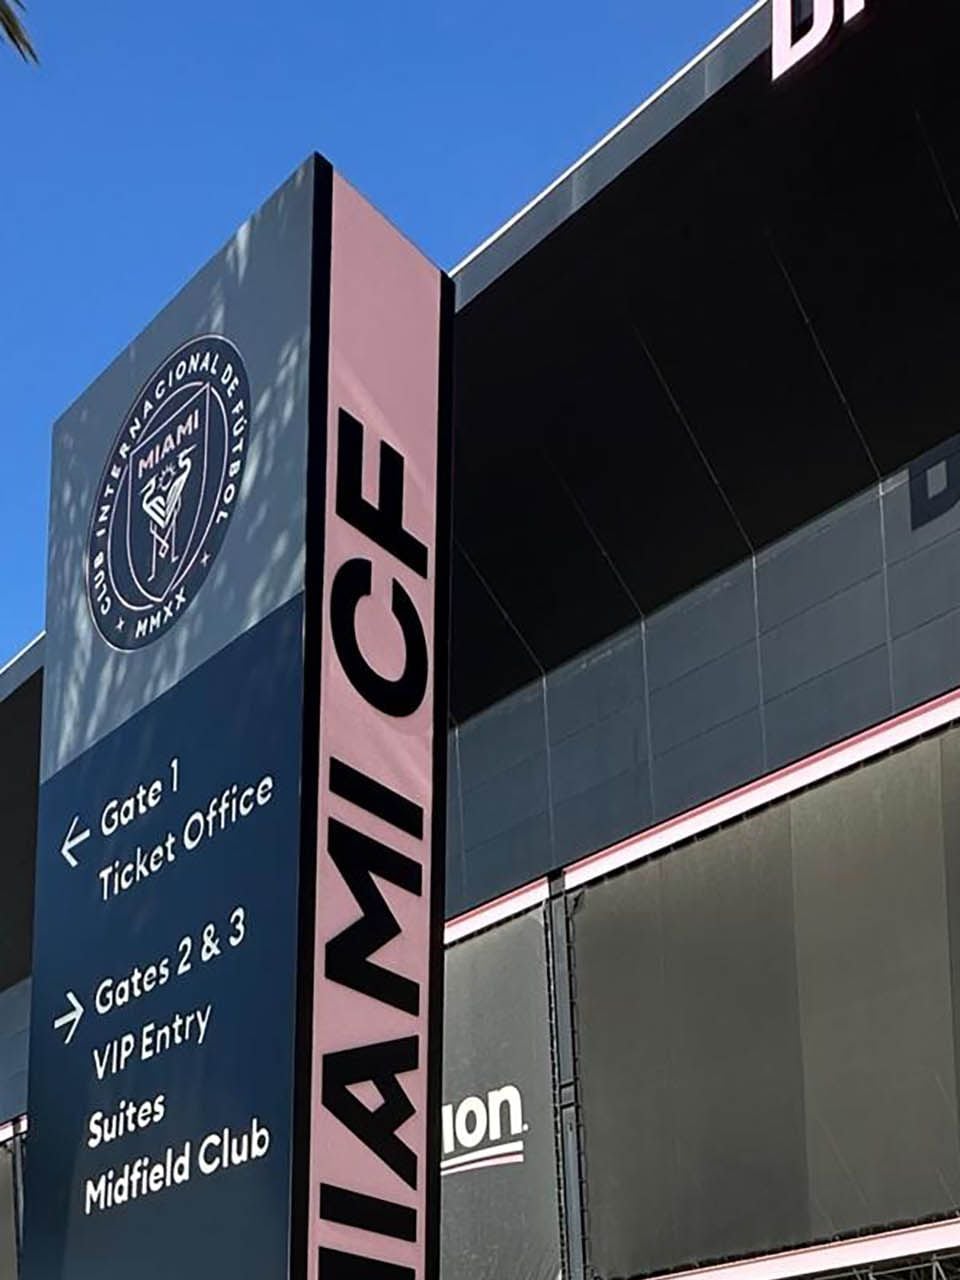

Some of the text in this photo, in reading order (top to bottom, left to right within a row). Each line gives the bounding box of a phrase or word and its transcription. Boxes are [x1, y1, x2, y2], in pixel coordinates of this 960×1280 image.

[221, 363, 240, 393] DE
[96, 351, 219, 538] INTERNACIONAL
[138, 409, 199, 479] MIAMI
[93, 550, 111, 616] CLUB
[330, 406, 429, 718] CF
[134, 587, 186, 638] MMXX
[101, 758, 180, 836] Gate 1
[98, 776, 274, 901] Ticket Office
[95, 907, 246, 1015] Gates 2 & 3
[93, 1004, 212, 1080] VIP Entry
[88, 1093, 165, 1149] Suites
[85, 1119, 270, 1214] Midfield Club
